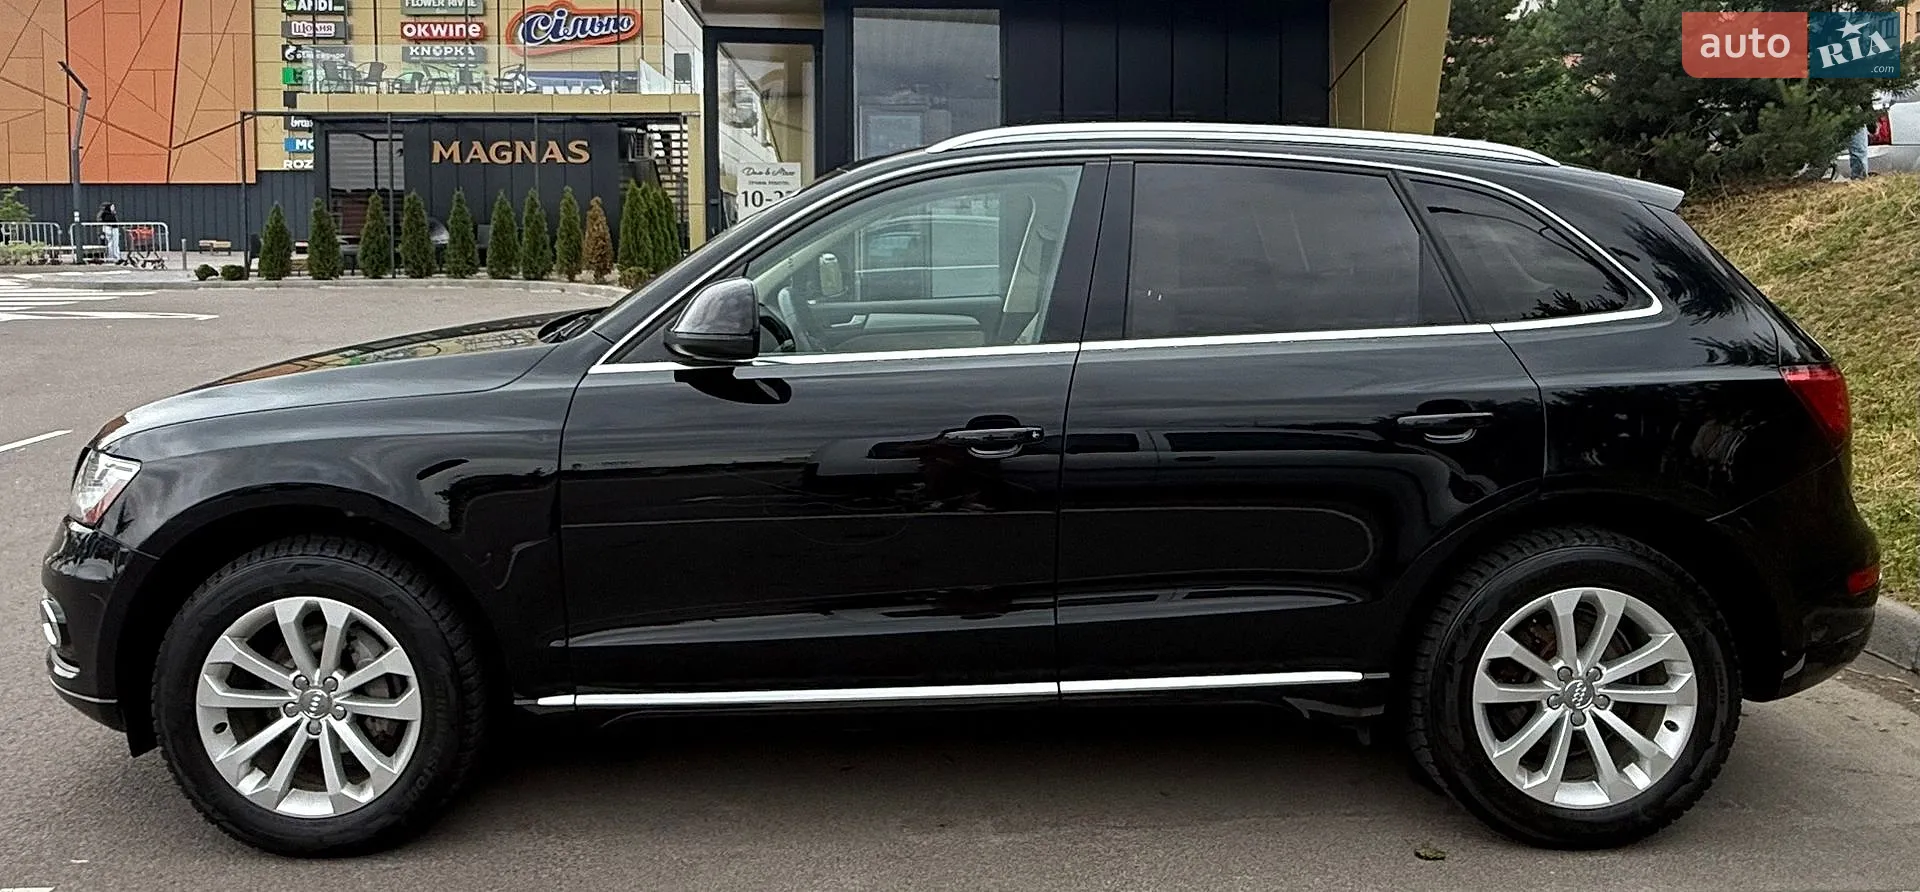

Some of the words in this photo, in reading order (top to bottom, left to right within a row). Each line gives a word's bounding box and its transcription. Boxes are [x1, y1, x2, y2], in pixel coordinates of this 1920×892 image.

[518, 8, 634, 47] Сільпо
[409, 46, 475, 56] KNOPKA
[431, 140, 590, 164] MAGNAS
[741, 190, 793, 208] 10-
